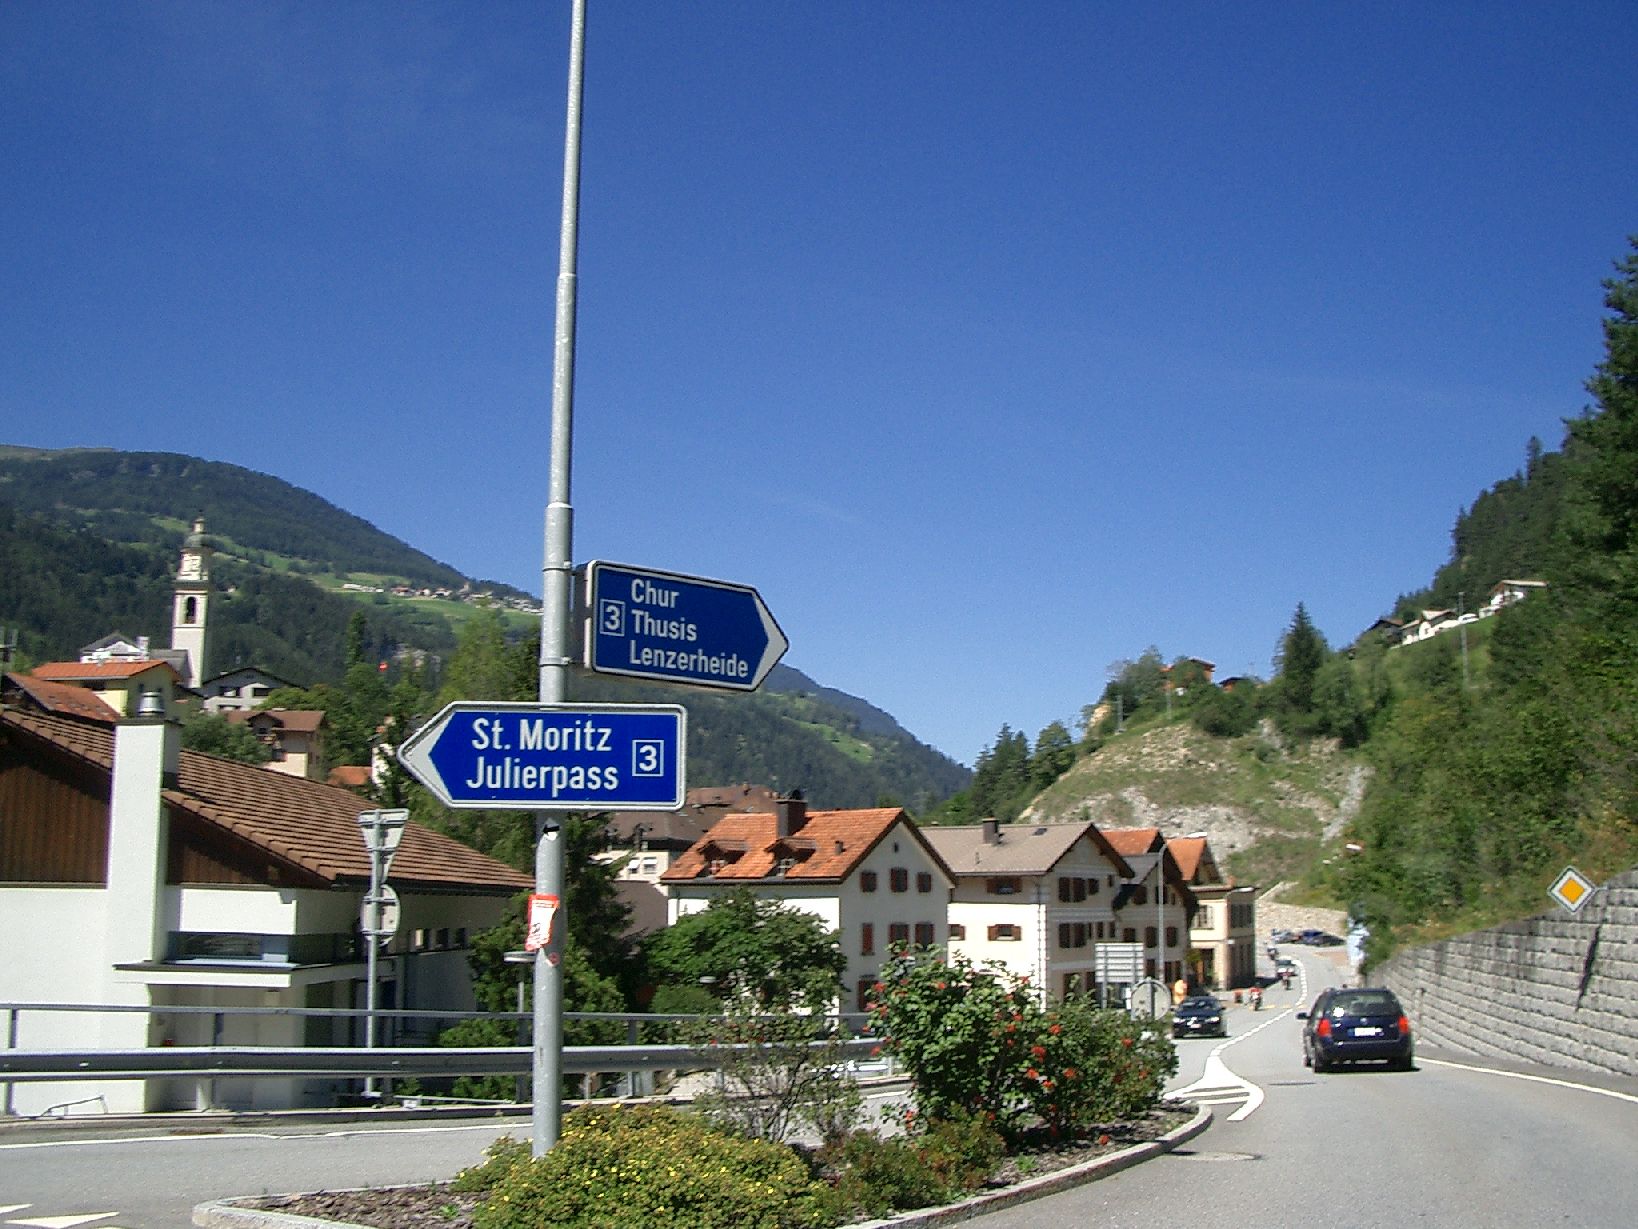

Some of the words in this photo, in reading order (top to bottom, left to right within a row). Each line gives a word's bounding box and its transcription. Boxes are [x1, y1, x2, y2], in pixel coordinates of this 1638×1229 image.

[630, 578, 680, 609] Chur
[604, 605, 621, 631] 3
[631, 609, 698, 641] Thusis
[629, 639, 749, 678] Lenzerheide
[471, 717, 511, 750] St.
[519, 718, 612, 751] Moritz
[638, 744, 658, 772] 3
[465, 756, 619, 798] Julierpass
